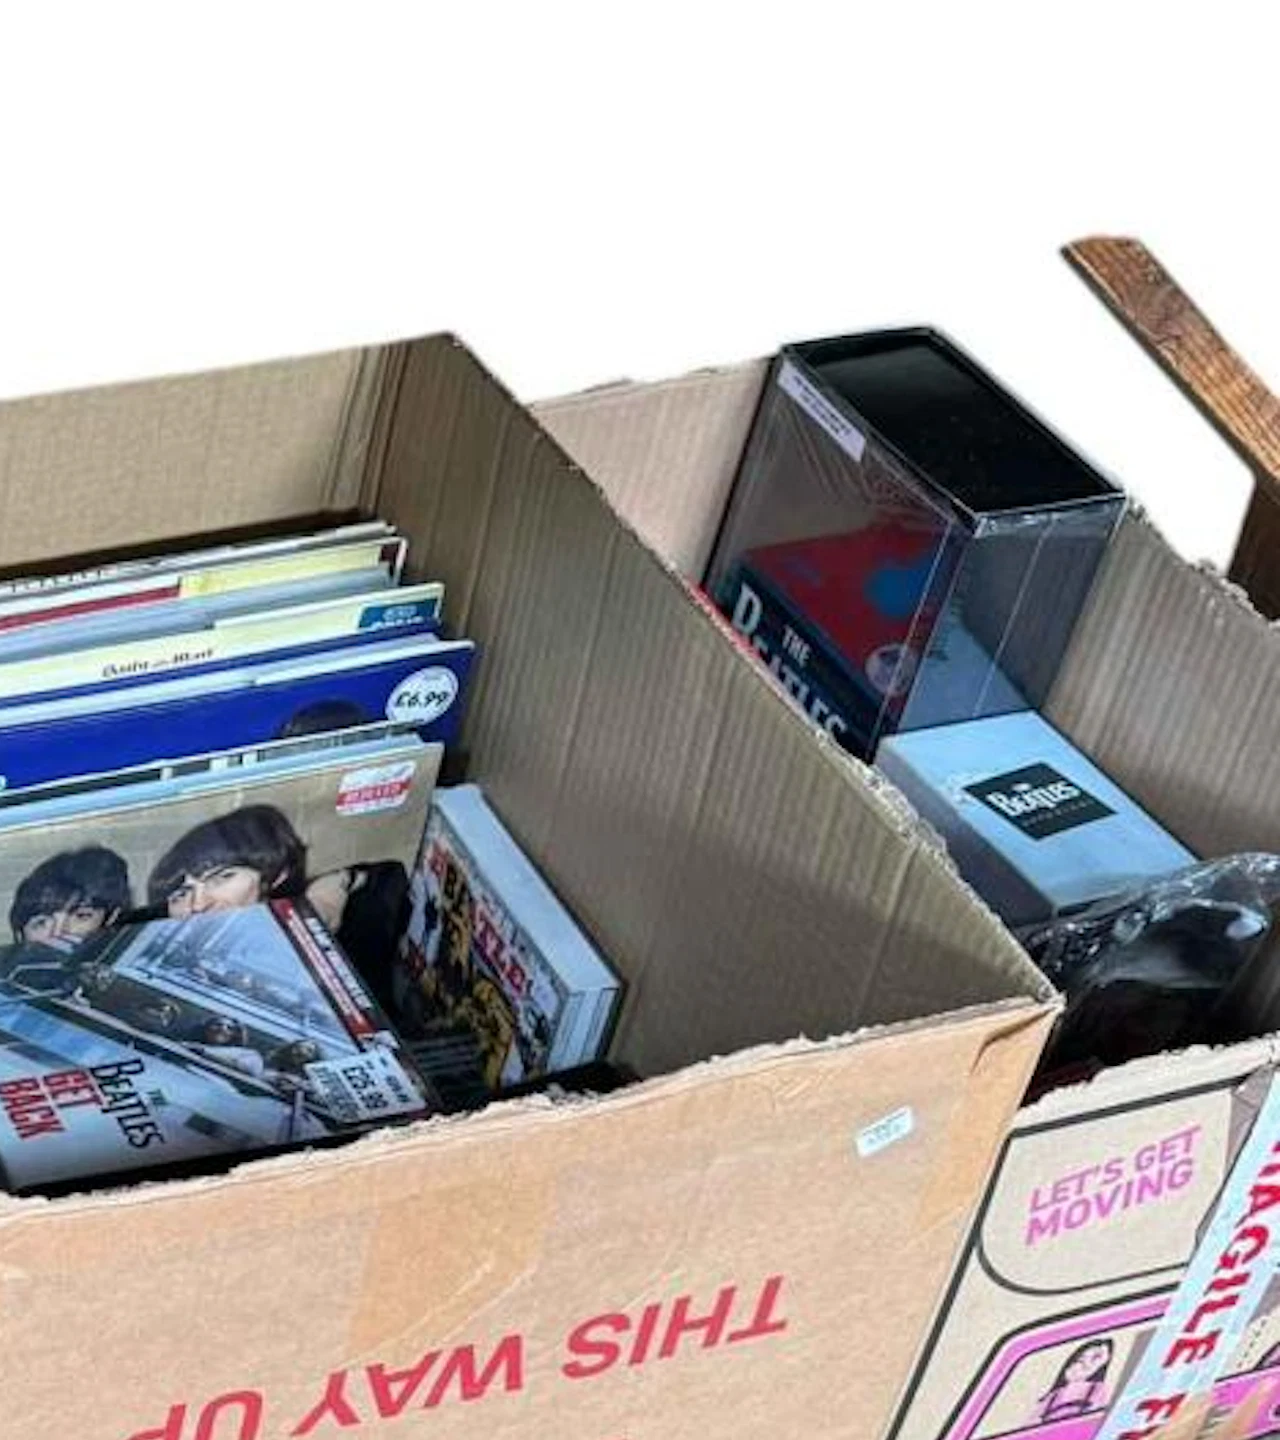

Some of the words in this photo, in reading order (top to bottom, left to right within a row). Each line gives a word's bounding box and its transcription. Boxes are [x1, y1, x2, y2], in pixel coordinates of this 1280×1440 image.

[394, 690, 450, 709] £6.99
[42, 1067, 104, 1110] GET
[90, 1057, 168, 1150] BEATLES
[1024, 1157, 1193, 1246] MOVING
[1030, 1156, 1125, 1213] LET'S
[1134, 1124, 1202, 1172] GET
[561, 1274, 788, 1380] THIS
[288, 1334, 525, 1440] WAY
